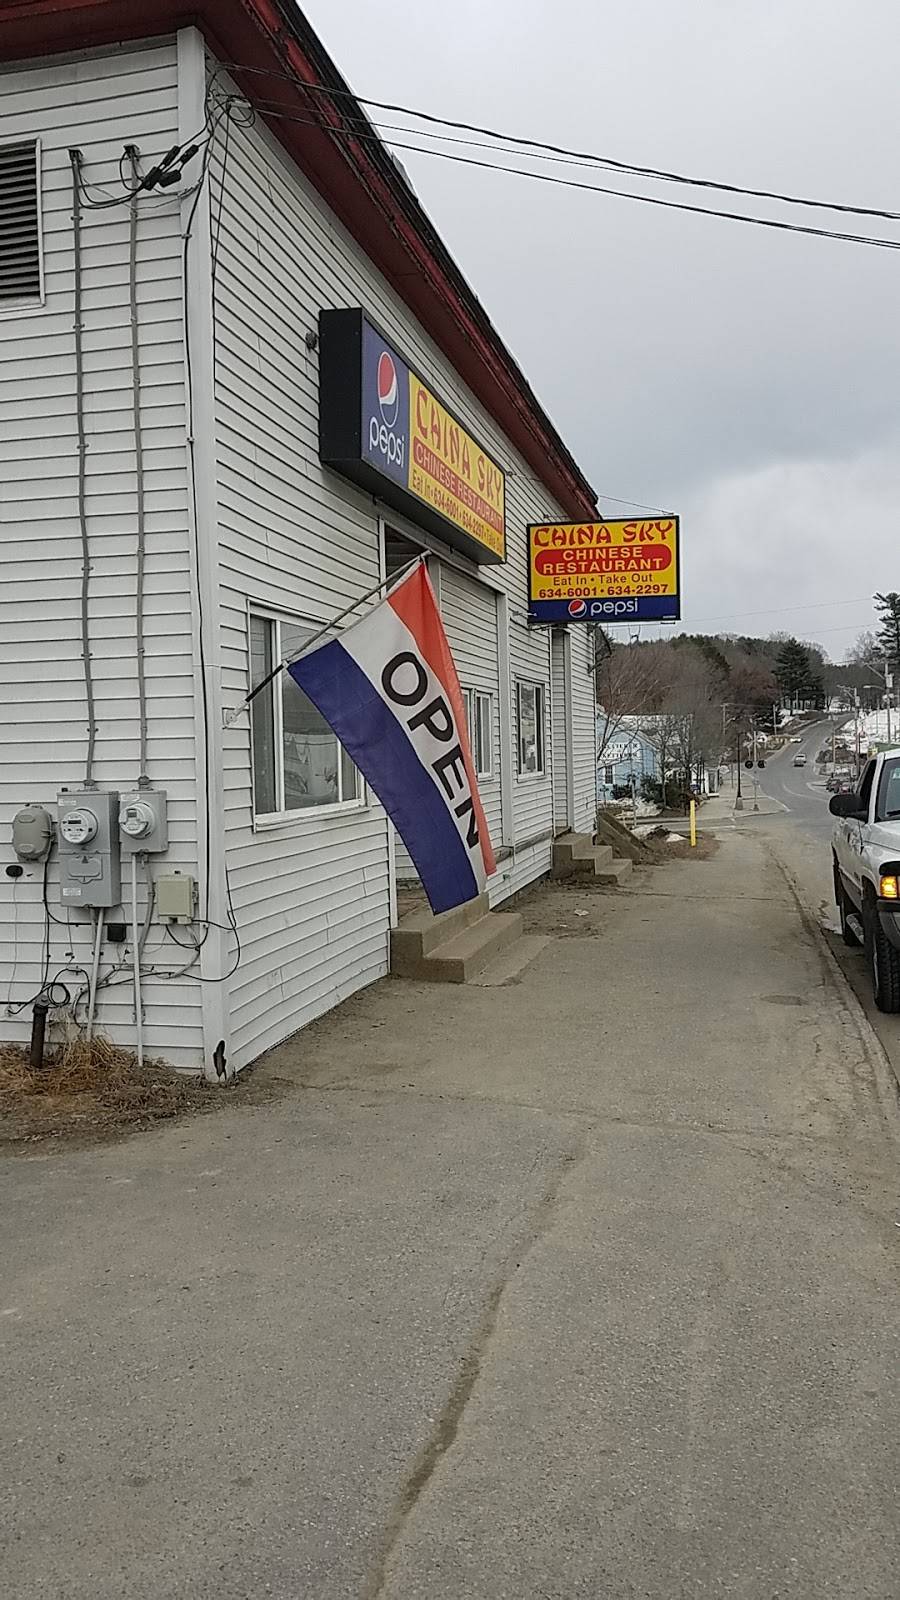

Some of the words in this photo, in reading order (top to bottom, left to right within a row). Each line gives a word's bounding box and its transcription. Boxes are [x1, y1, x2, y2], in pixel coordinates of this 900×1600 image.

[369, 416, 405, 468] pepsi
[416, 386, 471, 480] CHINA
[478, 455, 502, 507] SKY
[412, 469, 424, 494] Eat
[416, 443, 456, 492] CHINESE
[457, 482, 502, 532] RESTAURANT
[534, 524, 612, 547] CHINA
[622, 521, 673, 544] SKY
[563, 546, 643, 561] CHINESE
[543, 558, 663, 575] RESTAURANT
[538, 586, 598, 599] 634-6001
[607, 583, 669, 596] 634-2297
[553, 576, 572, 586] Eat
[576, 576, 587, 585] In
[599, 574, 627, 584] Take
[631, 573, 653, 583] Out
[590, 597, 639, 616] pepsi
[381, 651, 480, 849] OPEN
